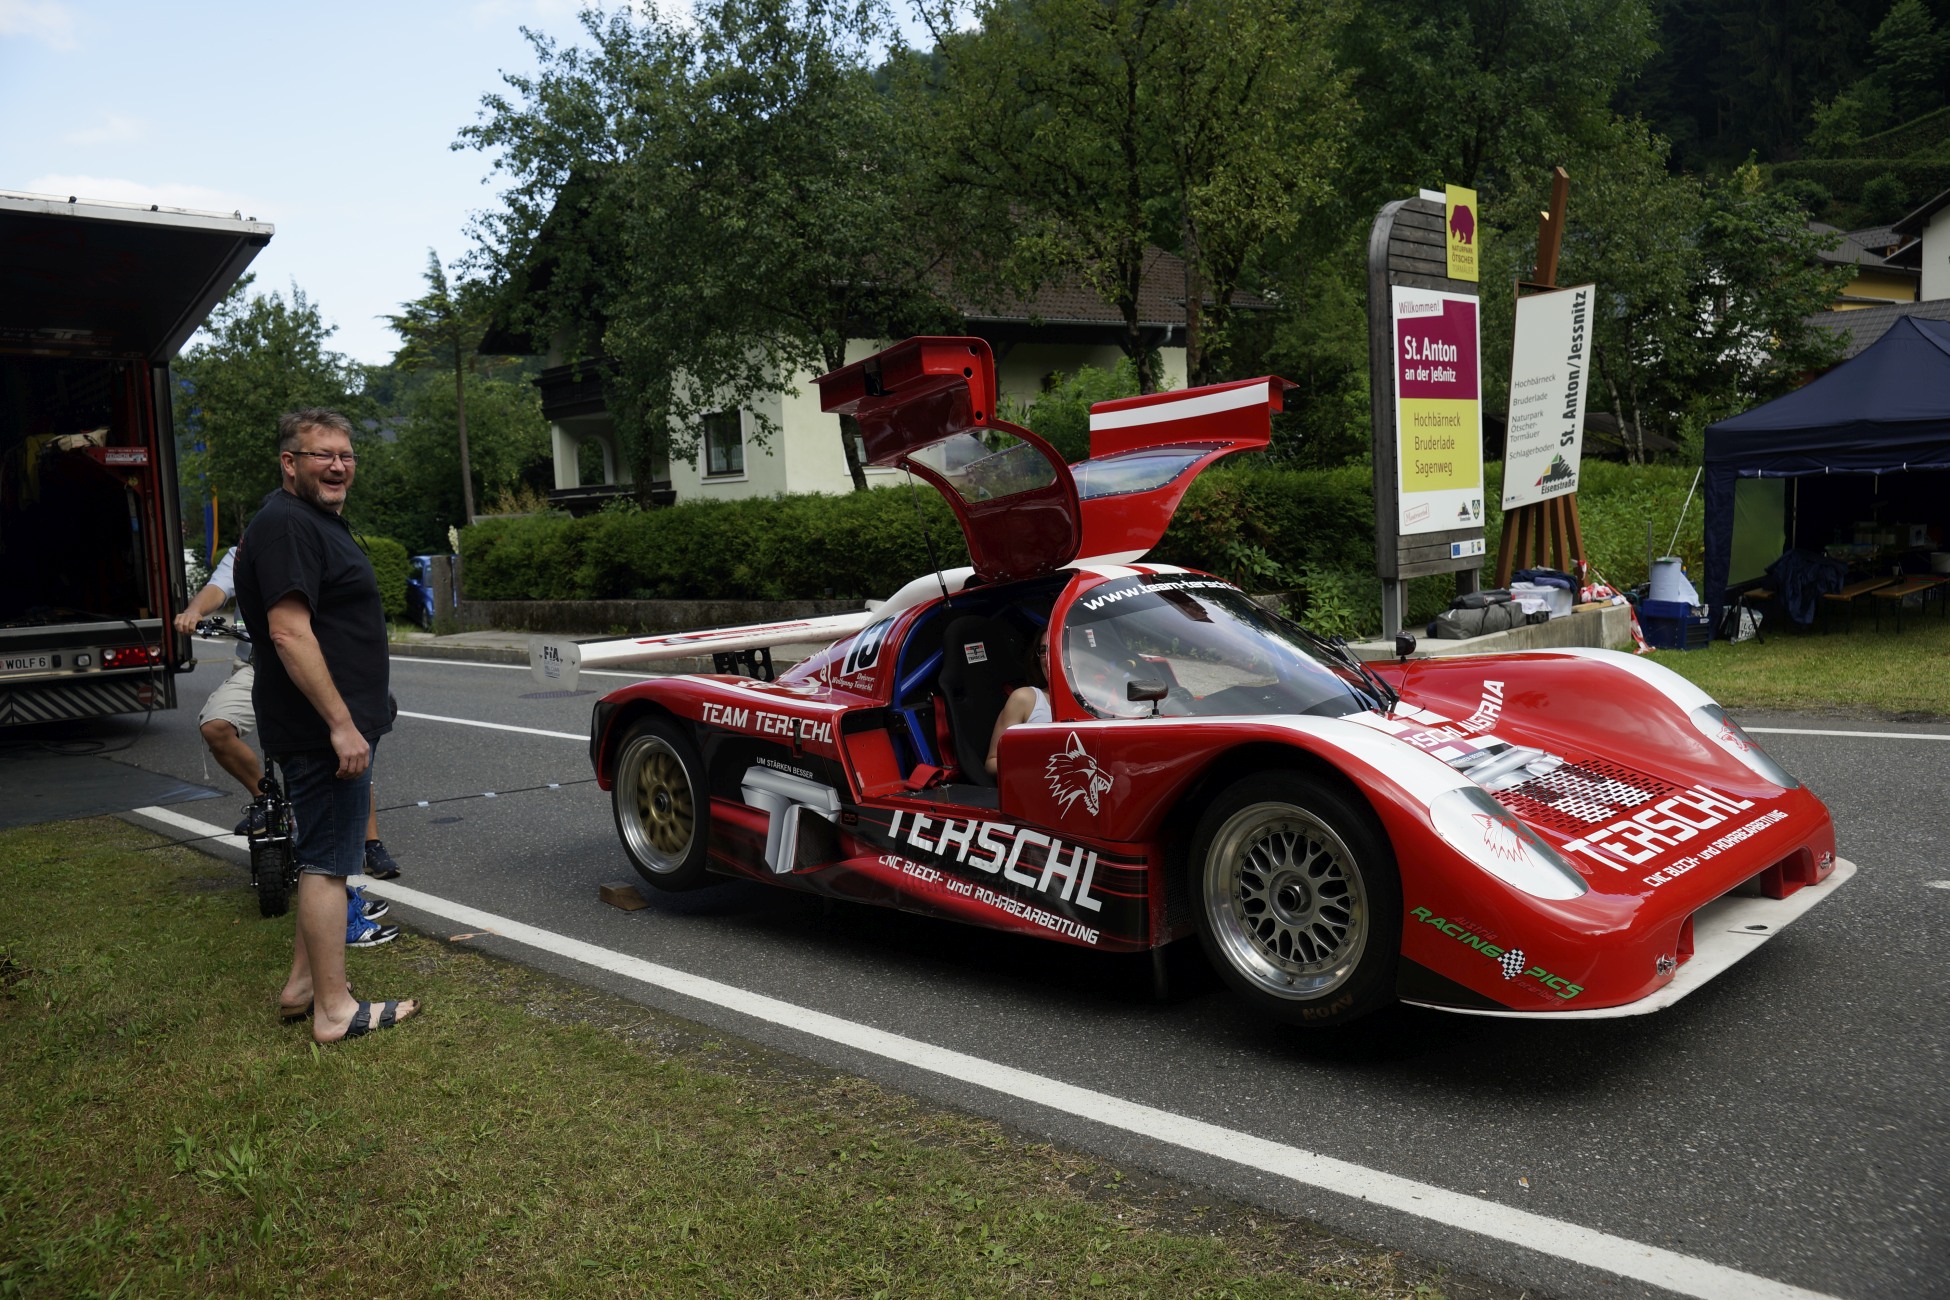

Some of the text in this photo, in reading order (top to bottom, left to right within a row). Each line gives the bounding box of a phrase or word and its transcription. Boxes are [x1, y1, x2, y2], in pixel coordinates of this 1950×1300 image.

[1452, 252, 1474, 264] ÖTSCHER
[1399, 300, 1440, 314] Willkommen!
[1404, 335, 1457, 362] St. Anton
[1405, 365, 1456, 383] an der Jeßnitz
[1560, 290, 1587, 448] St. Anton/Jessnitz
[1514, 374, 1556, 389] Hochbärneck
[1512, 392, 1548, 406] Bruderlade
[1414, 411, 1461, 427] Hochbärneck
[1512, 410, 1544, 424] Naturpark
[1510, 422, 1538, 434] Ötscher-
[1510, 430, 1540, 443] Tormäuer
[1414, 434, 1455, 450] Bruderlade
[1509, 442, 1554, 460] Schlagerboden
[1415, 460, 1452, 478] Sagenweg
[1541, 479, 1576, 495] Eisenstraße
[6, 656, 46, 670] WOLF 6
[832, 676, 874, 692] Wolfgang Terschl
[1456, 680, 1504, 734] AUSTRIA
[702, 702, 833, 744] TEAM TERSCHL
[756, 756, 814, 780] UM STÄRKEN BESSER
[1561, 784, 1756, 872] TERSCHL
[1643, 809, 1788, 888] CNC BLECH- und ROHRBEARBEITUNG
[878, 854, 1100, 946] CNC BLECH- und ROHRBEARBEITUNG
[1451, 916, 1498, 941] Austria
[1410, 906, 1584, 1000] RACING PICS
